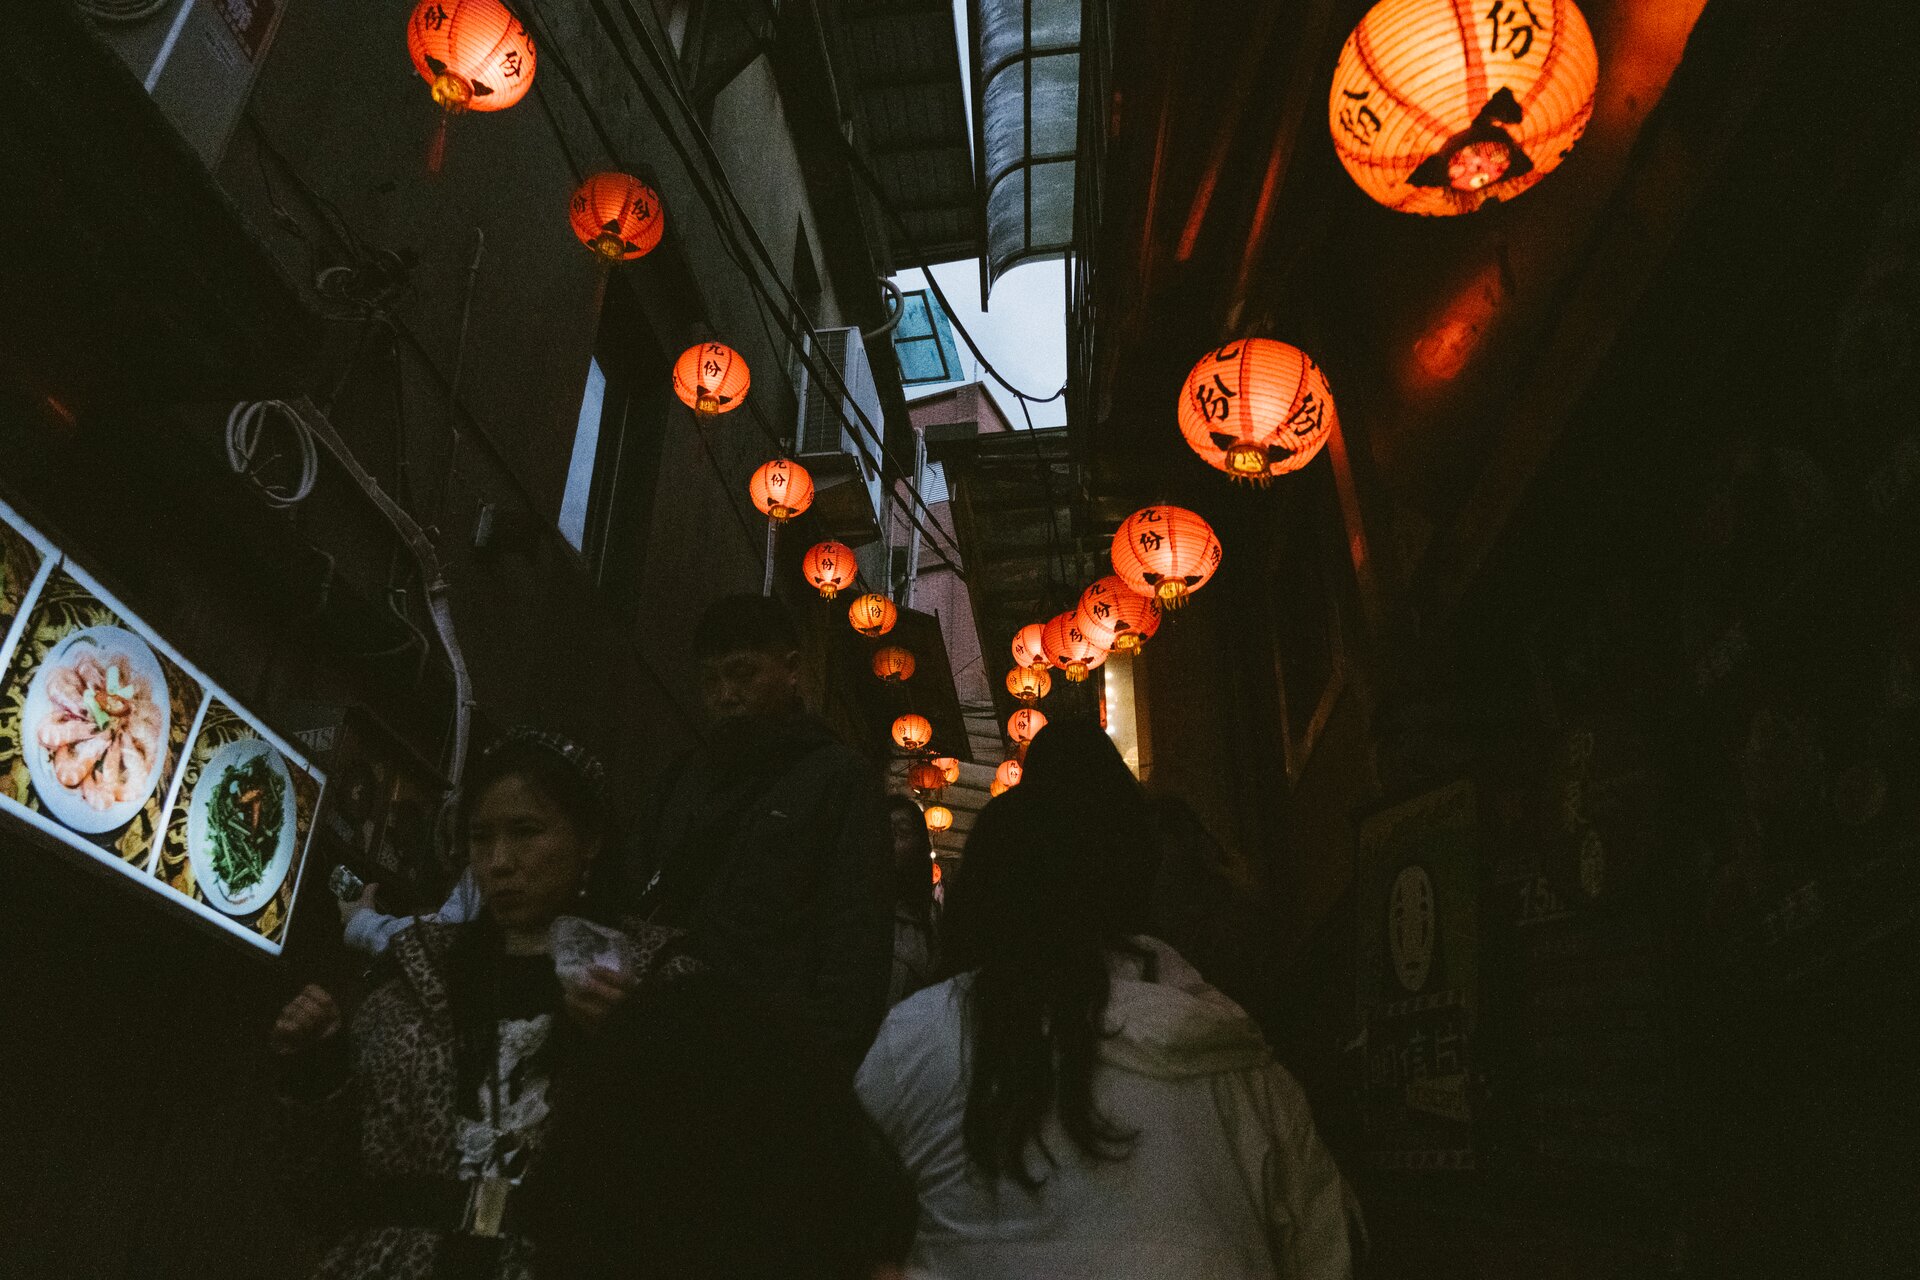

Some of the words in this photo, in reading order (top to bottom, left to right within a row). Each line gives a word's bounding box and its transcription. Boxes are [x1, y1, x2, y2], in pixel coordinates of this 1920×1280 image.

[704, 344, 726, 378] 九份
[771, 459, 787, 488] 九份
[1138, 509, 1165, 552] 九份
[821, 544, 835, 571] 九份
[1089, 582, 1113, 621] 九份
